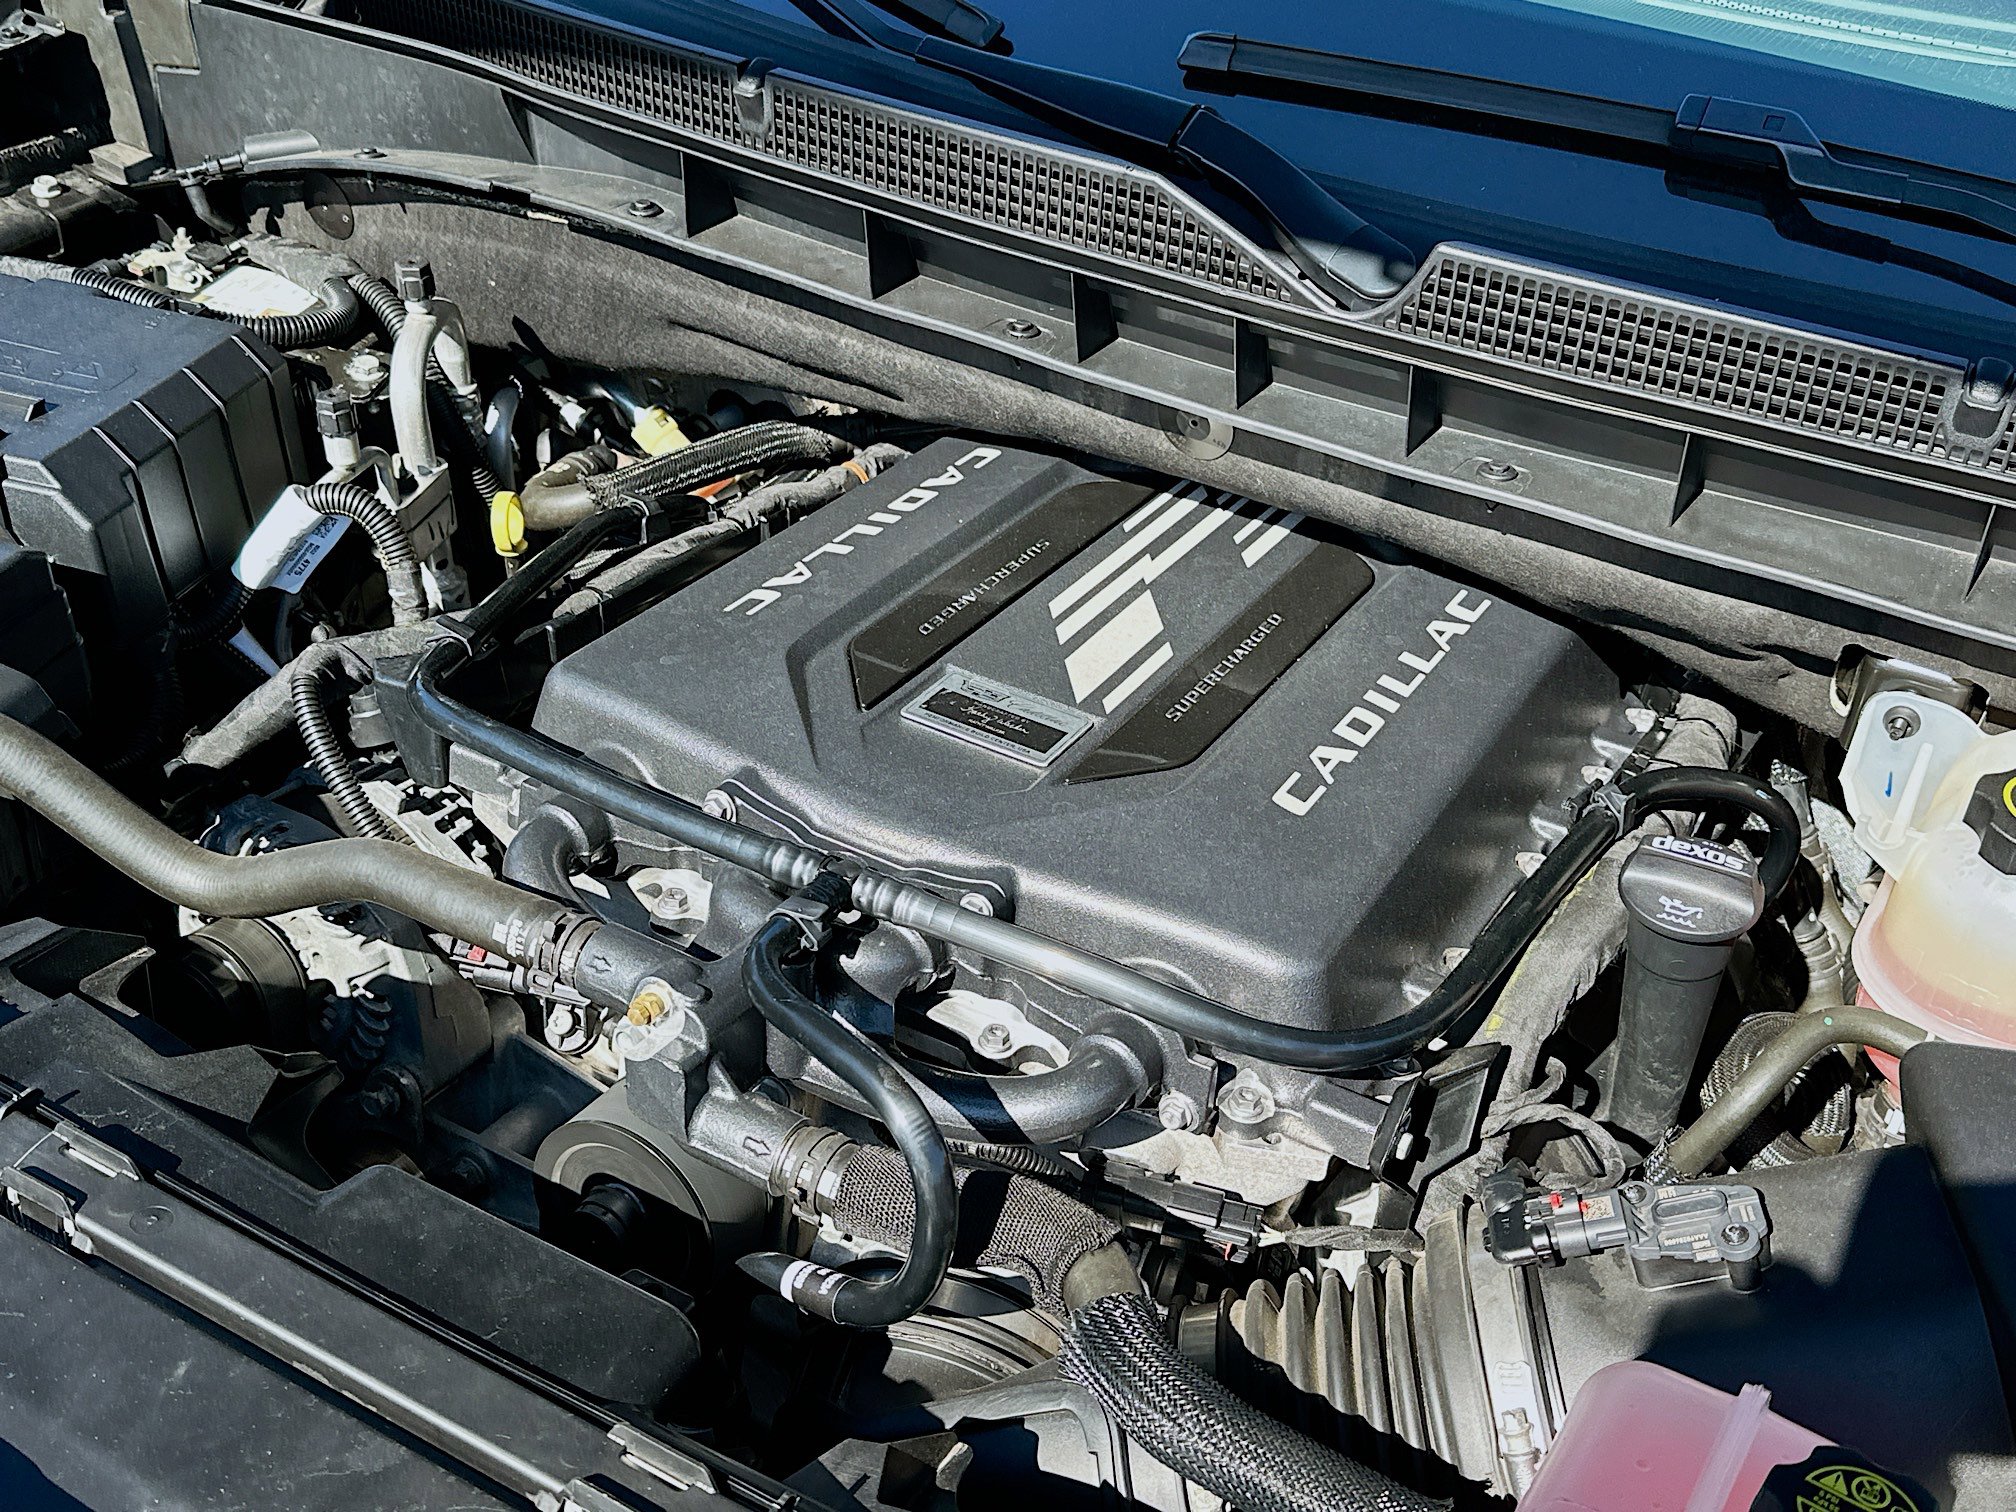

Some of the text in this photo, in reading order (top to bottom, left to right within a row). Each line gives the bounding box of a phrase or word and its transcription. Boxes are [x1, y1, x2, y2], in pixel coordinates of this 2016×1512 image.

[294, 558, 311, 577] 4775
[722, 446, 1002, 616] CADILLAC
[918, 537, 1050, 636] SUPERCHARGED
[1164, 612, 1284, 723] SUPERCHARGED
[1272, 589, 1492, 817] CADILLAC
[1651, 835, 1749, 871] dexos
